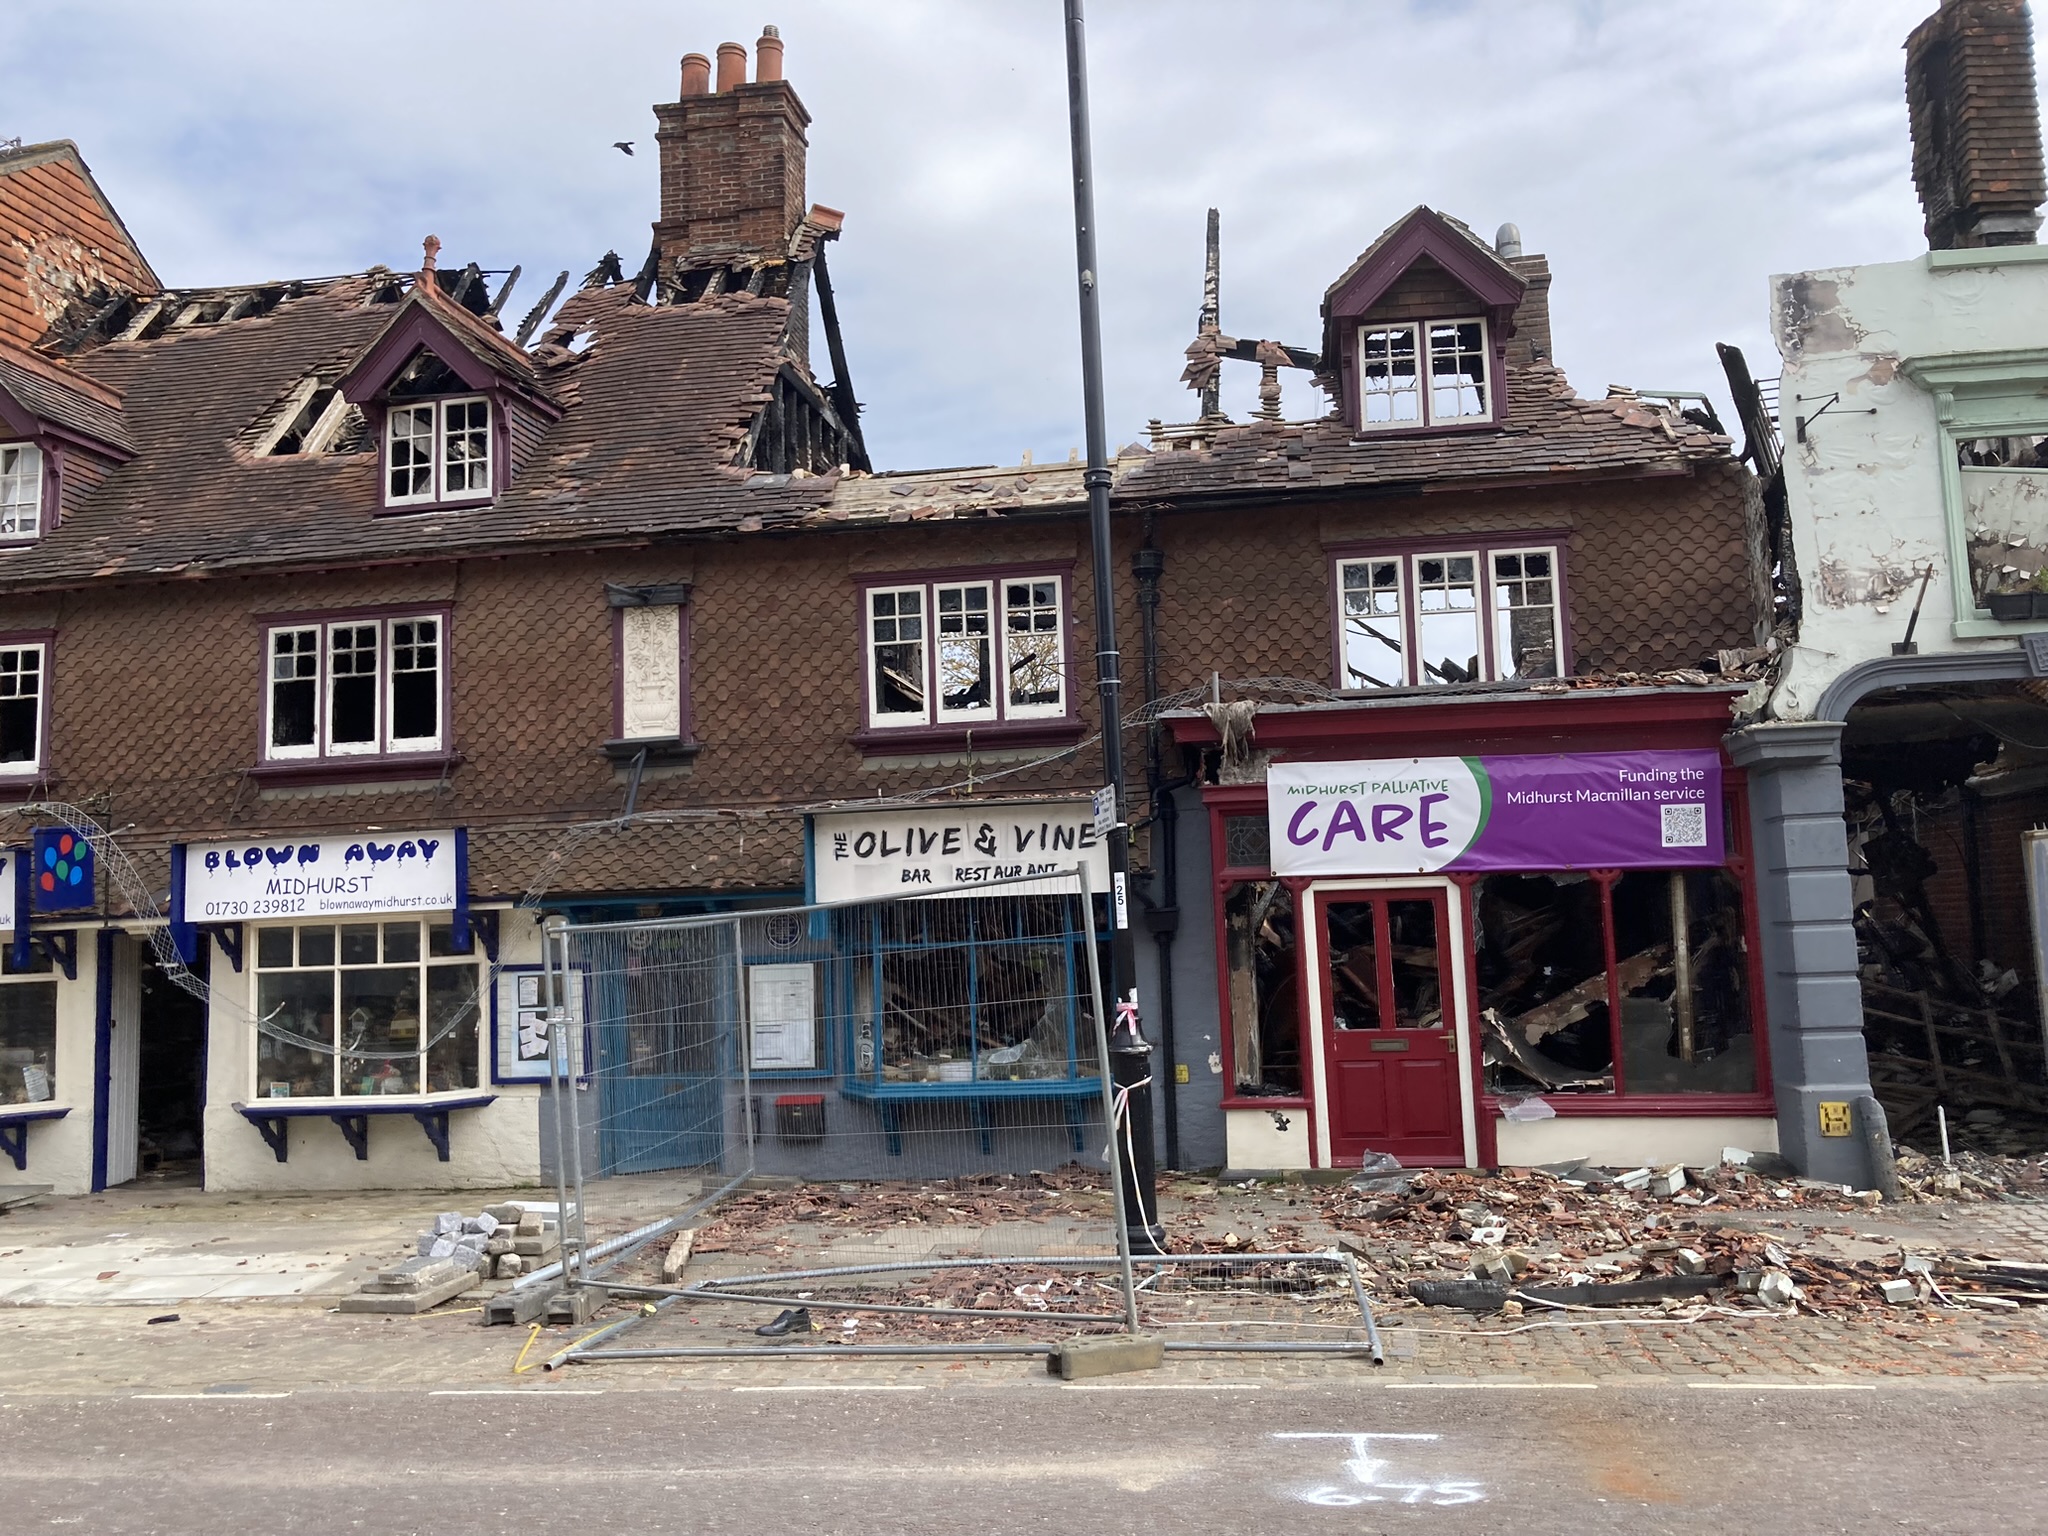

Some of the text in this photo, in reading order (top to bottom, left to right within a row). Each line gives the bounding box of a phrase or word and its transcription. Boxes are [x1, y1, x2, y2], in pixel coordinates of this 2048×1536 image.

[1619, 768, 1705, 783] Funding the
[1287, 779, 1449, 795] MIDHURST PALLIATIVE
[1506, 786, 1705, 805] Midhurst Macmillan service
[1287, 793, 1450, 851] CARE
[834, 822, 1098, 860] THE OLIVE & VINE
[205, 839, 439, 876] BLOWN AWAY
[902, 868, 932, 883] BAR
[266, 876, 373, 895] MIDHURST
[206, 893, 453, 916] 01730 239812 blownawaymidhurst.co.uk
